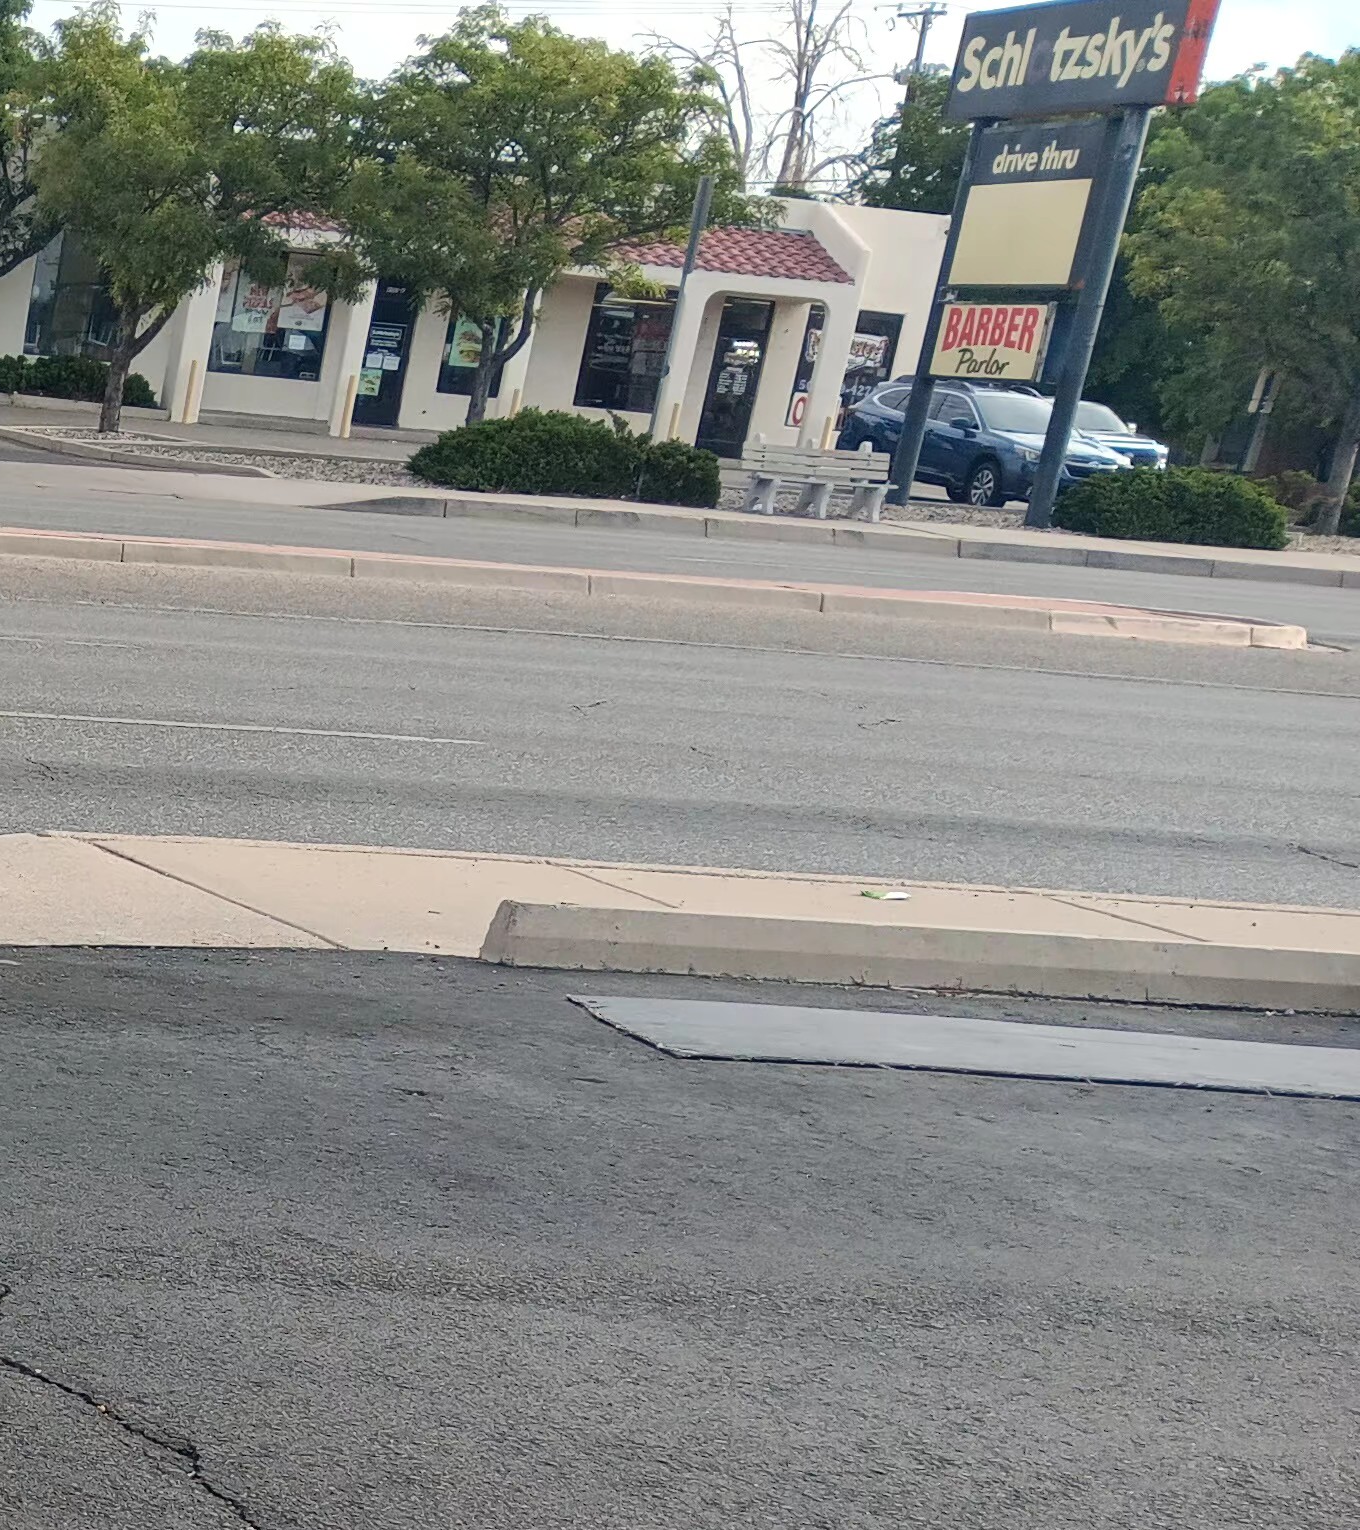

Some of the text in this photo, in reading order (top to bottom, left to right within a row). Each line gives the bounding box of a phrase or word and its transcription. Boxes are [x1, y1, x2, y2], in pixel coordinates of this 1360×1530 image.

[957, 12, 1175, 92] Schltzsky's
[992, 140, 1080, 174] drive thru
[941, 307, 1040, 354] BARBER
[955, 348, 1010, 375] Parlor
